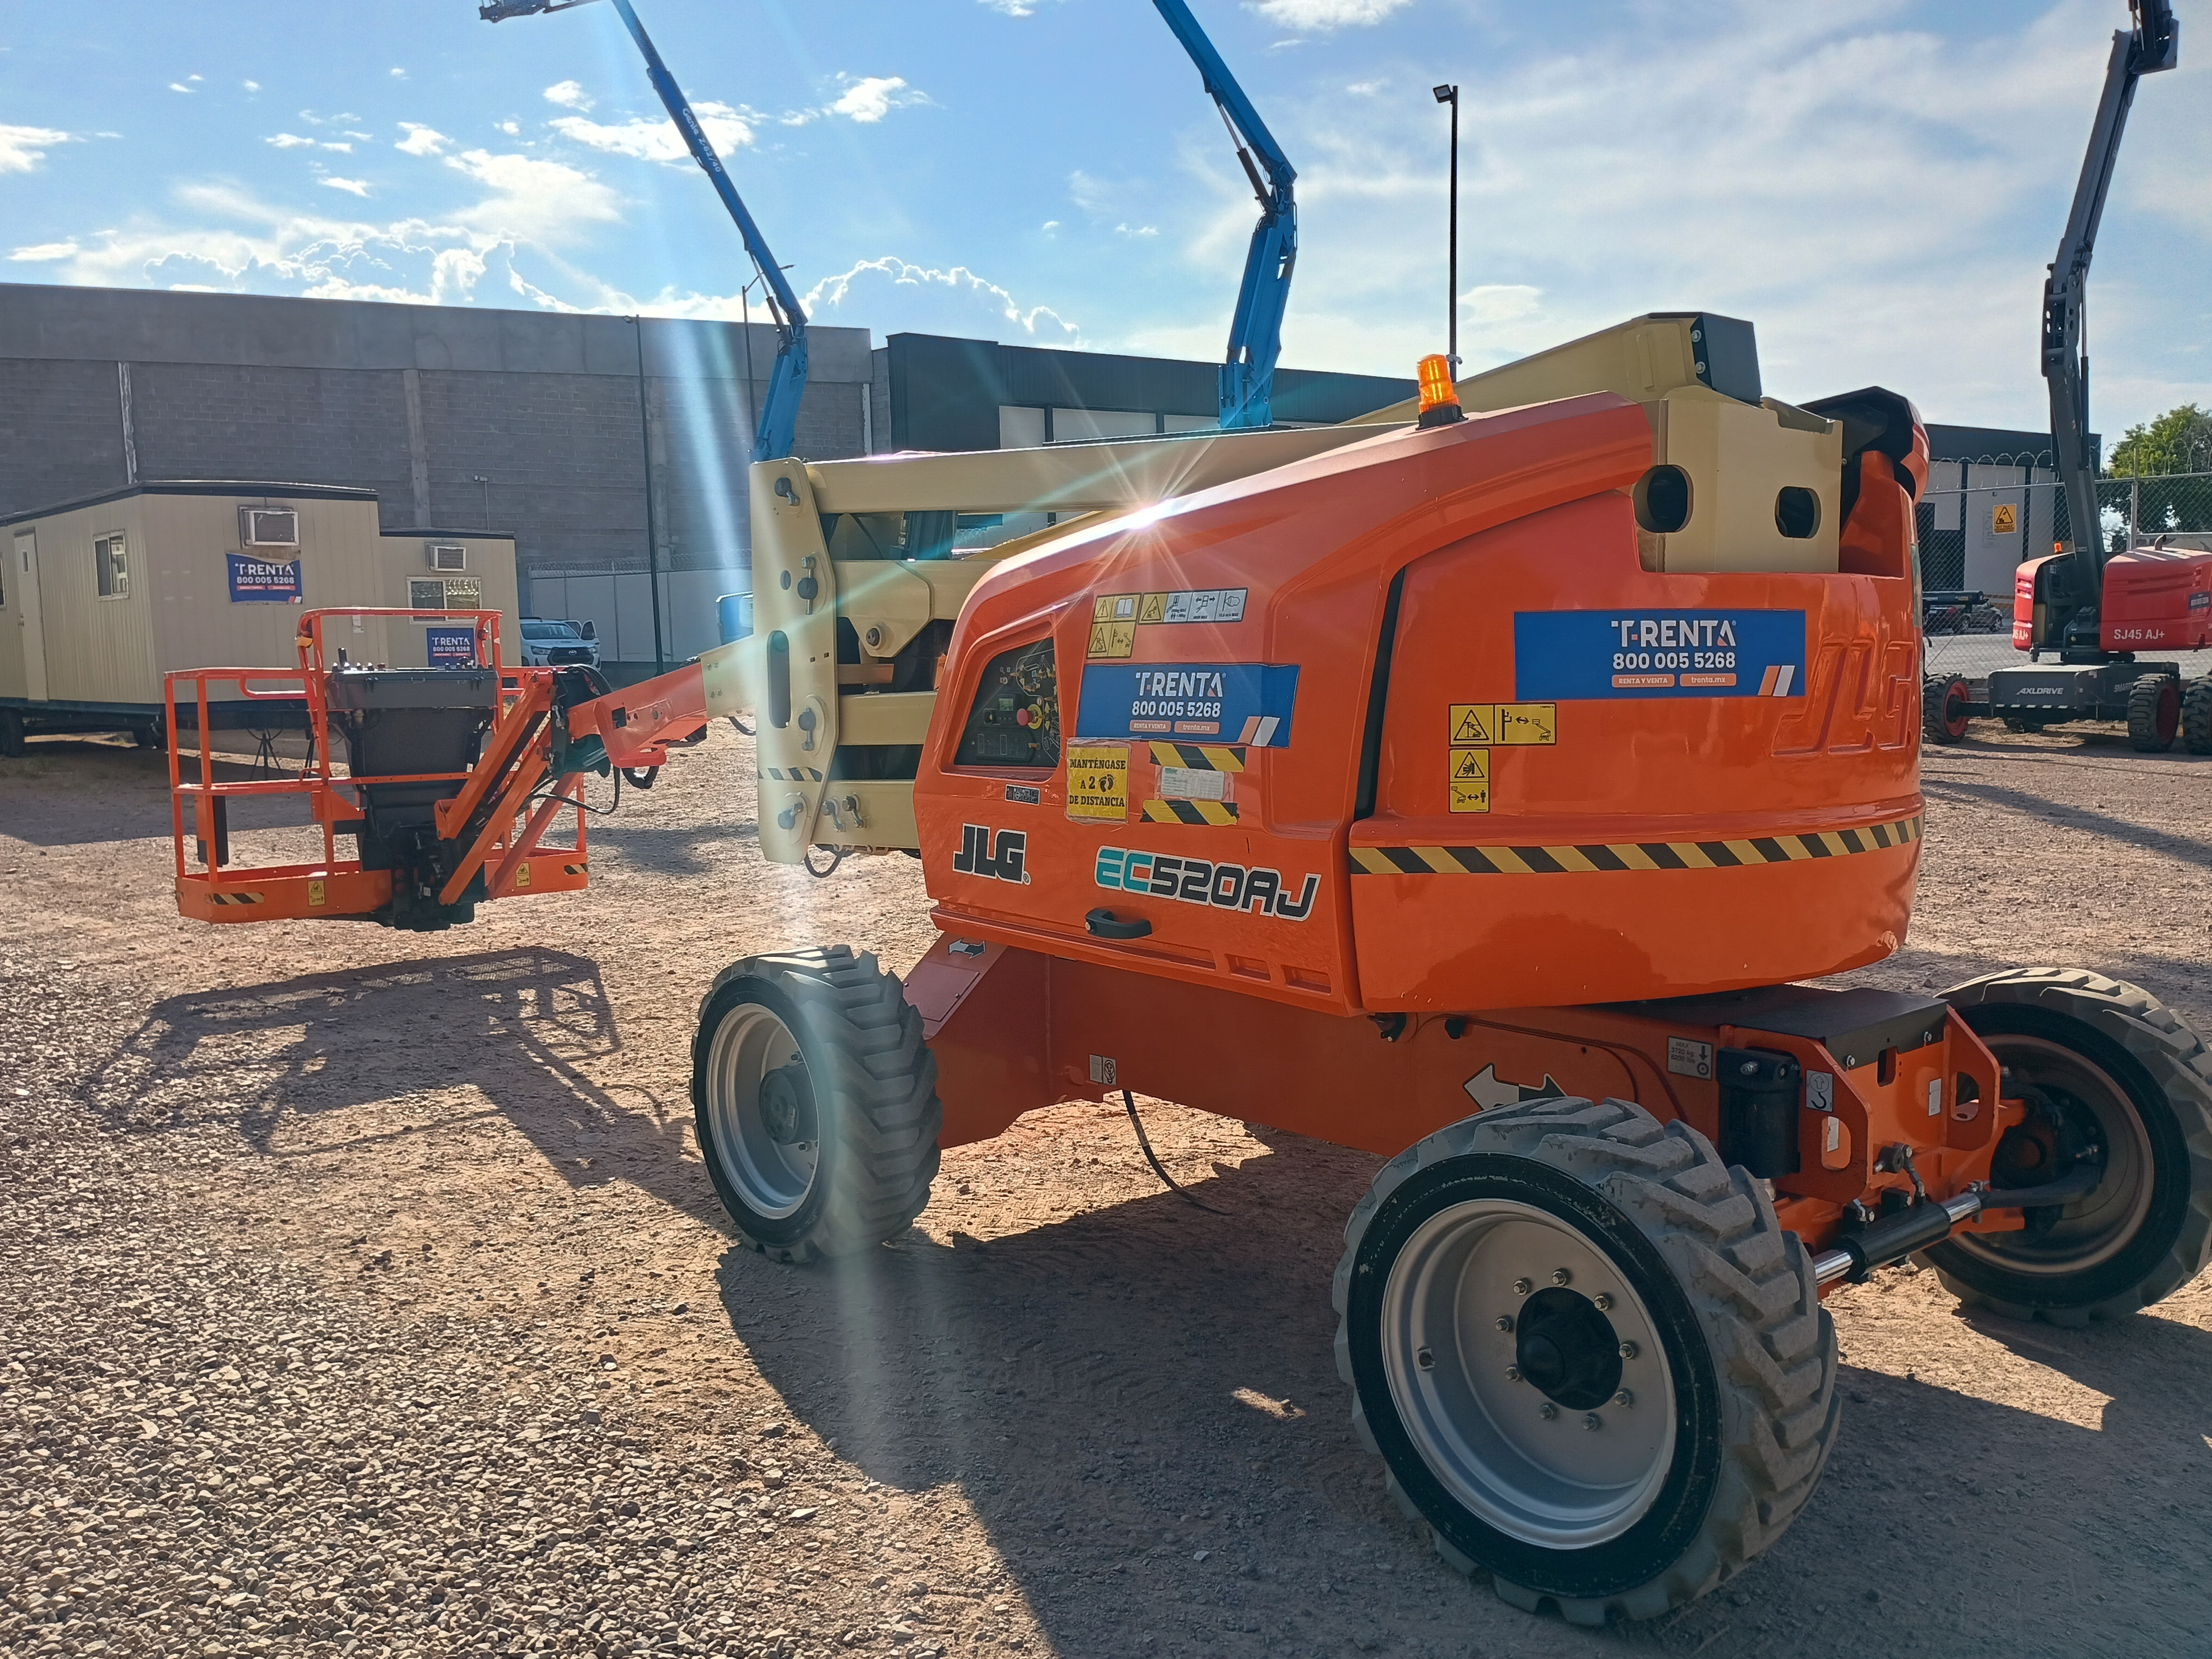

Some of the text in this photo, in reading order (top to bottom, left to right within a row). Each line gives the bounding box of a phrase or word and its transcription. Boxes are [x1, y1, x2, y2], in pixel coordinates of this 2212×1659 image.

[682, 108, 721, 172] Genie Z-62/40
[2113, 629, 2165, 639] SJ45 AJ+
[1613, 652, 1736, 669] 800 005 5268
[1132, 700, 1221, 718] 800 005 5268
[1070, 757, 1126, 770] MANTÉNGASE
[1080, 775, 1096, 789] A 2
[1069, 795, 1125, 807] DE DISTANCIA
[953, 823, 1027, 884] JLG
[1095, 846, 1321, 921] EC520AJ
